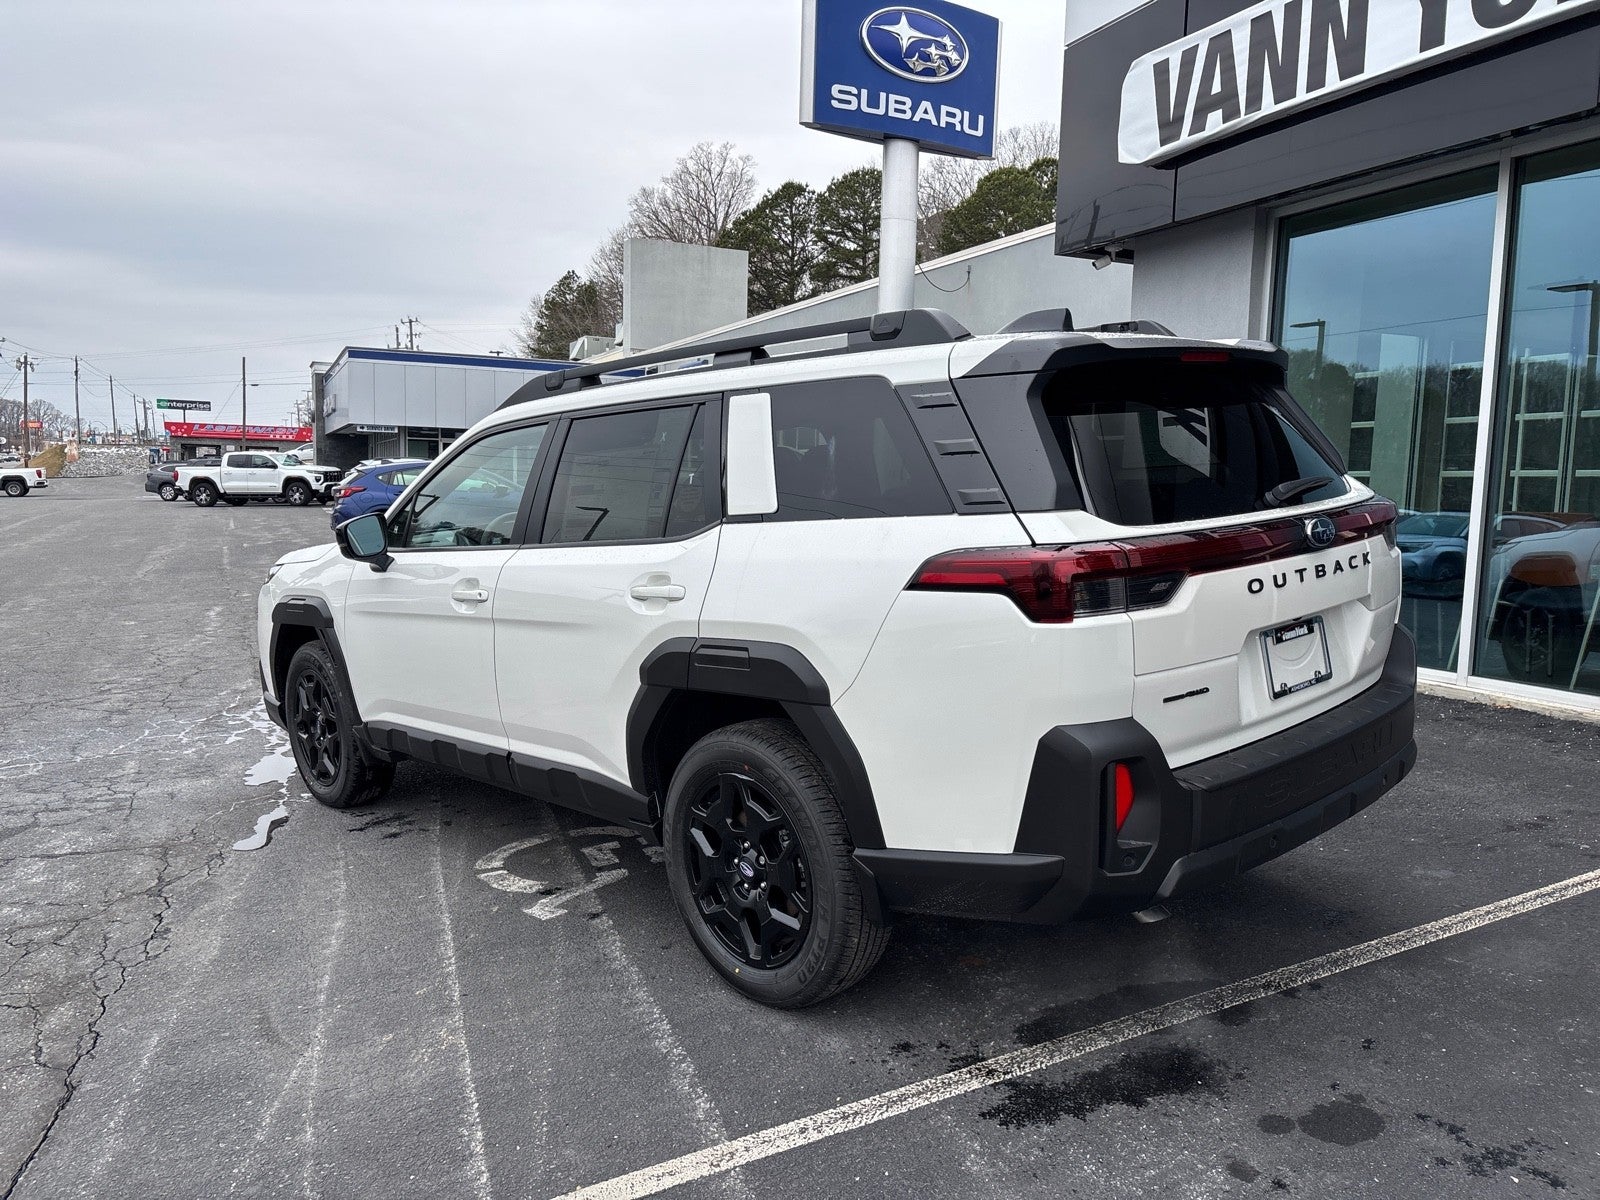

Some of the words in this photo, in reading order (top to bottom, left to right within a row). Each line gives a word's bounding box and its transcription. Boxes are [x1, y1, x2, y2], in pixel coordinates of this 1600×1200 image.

[1153, 0, 1370, 147] VANN
[831, 84, 984, 137] SUBARU
[158, 400, 210, 409] enterprise
[1247, 552, 1371, 594] OUTBACK
